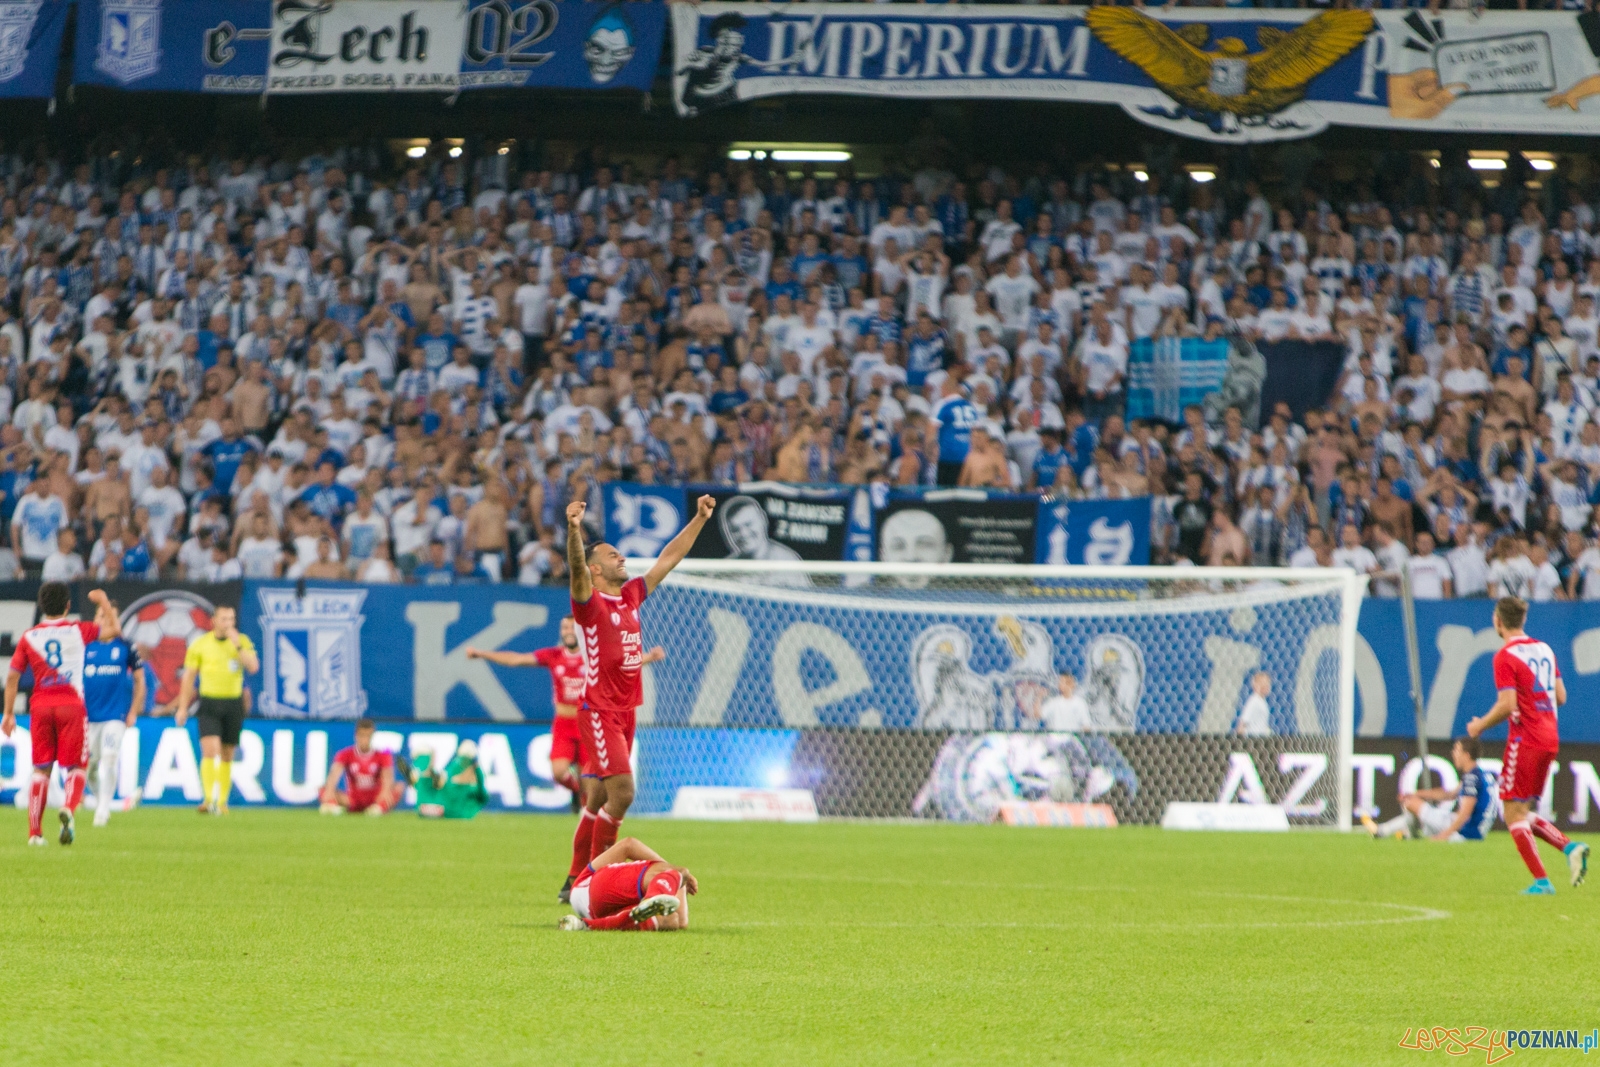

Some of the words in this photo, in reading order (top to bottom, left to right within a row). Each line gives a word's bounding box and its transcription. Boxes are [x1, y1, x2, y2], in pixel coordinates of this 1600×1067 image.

[761, 19, 1089, 77] IMPERIUM
[44, 639, 63, 669] 8
[1527, 657, 1554, 692] 22
